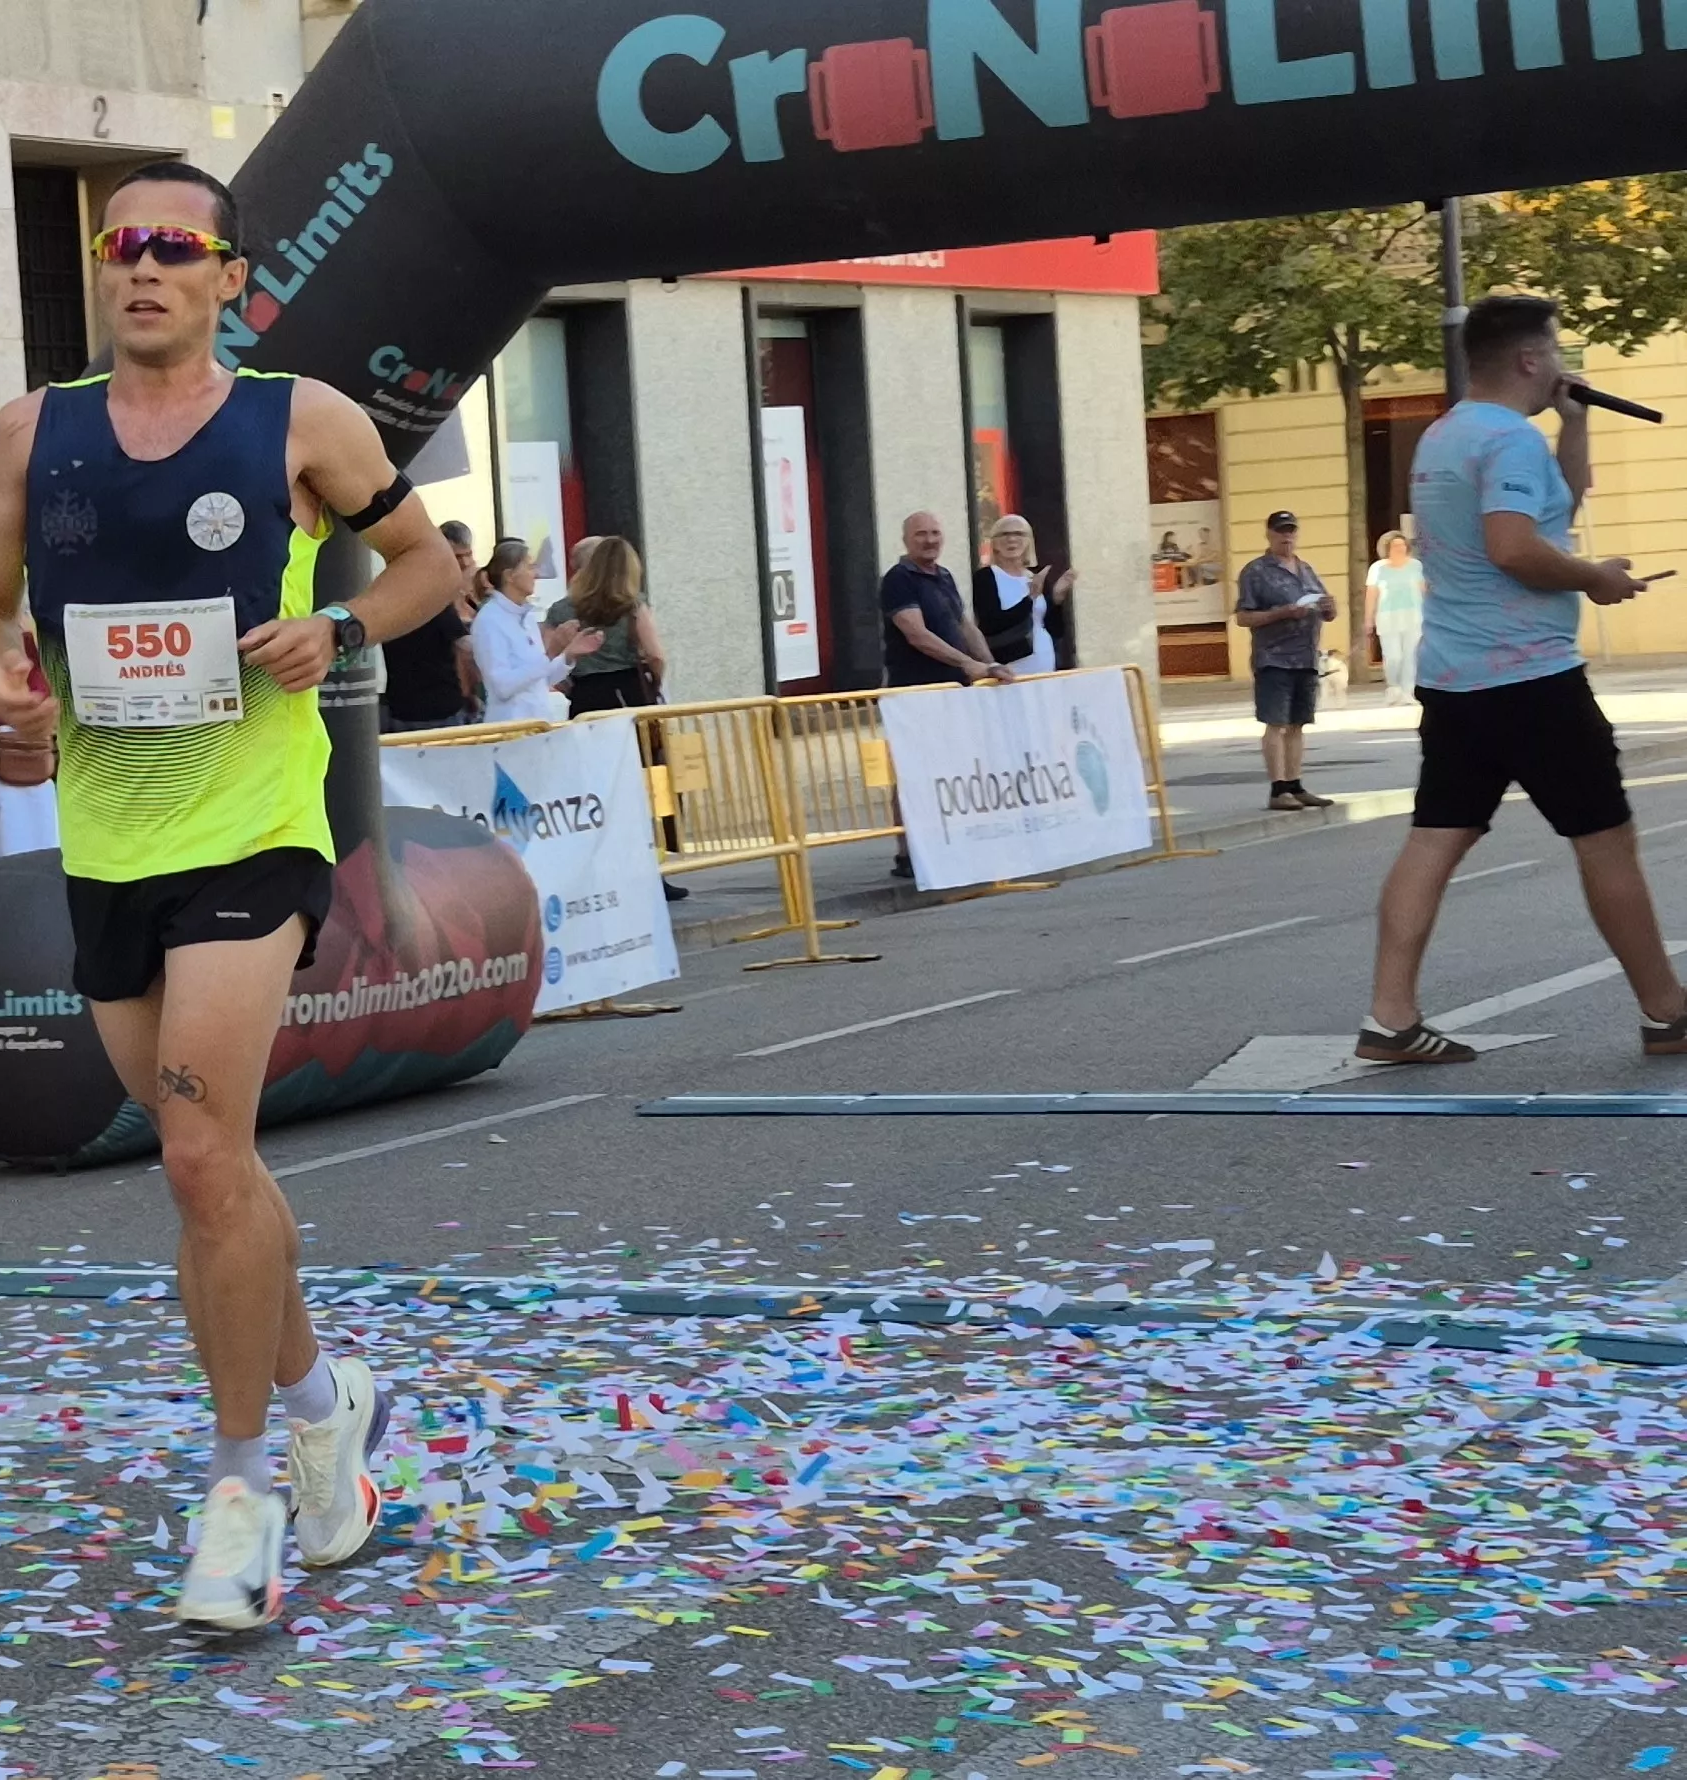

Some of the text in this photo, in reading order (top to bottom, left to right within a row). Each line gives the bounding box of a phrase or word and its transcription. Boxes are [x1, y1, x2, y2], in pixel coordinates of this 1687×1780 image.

[92, 94, 110, 139] 2
[107, 622, 192, 660] 550
[119, 660, 186, 679] ANDRÉS
[935, 752, 1077, 844] podoactiva
[281, 952, 528, 1026] ronolimits2020.com
